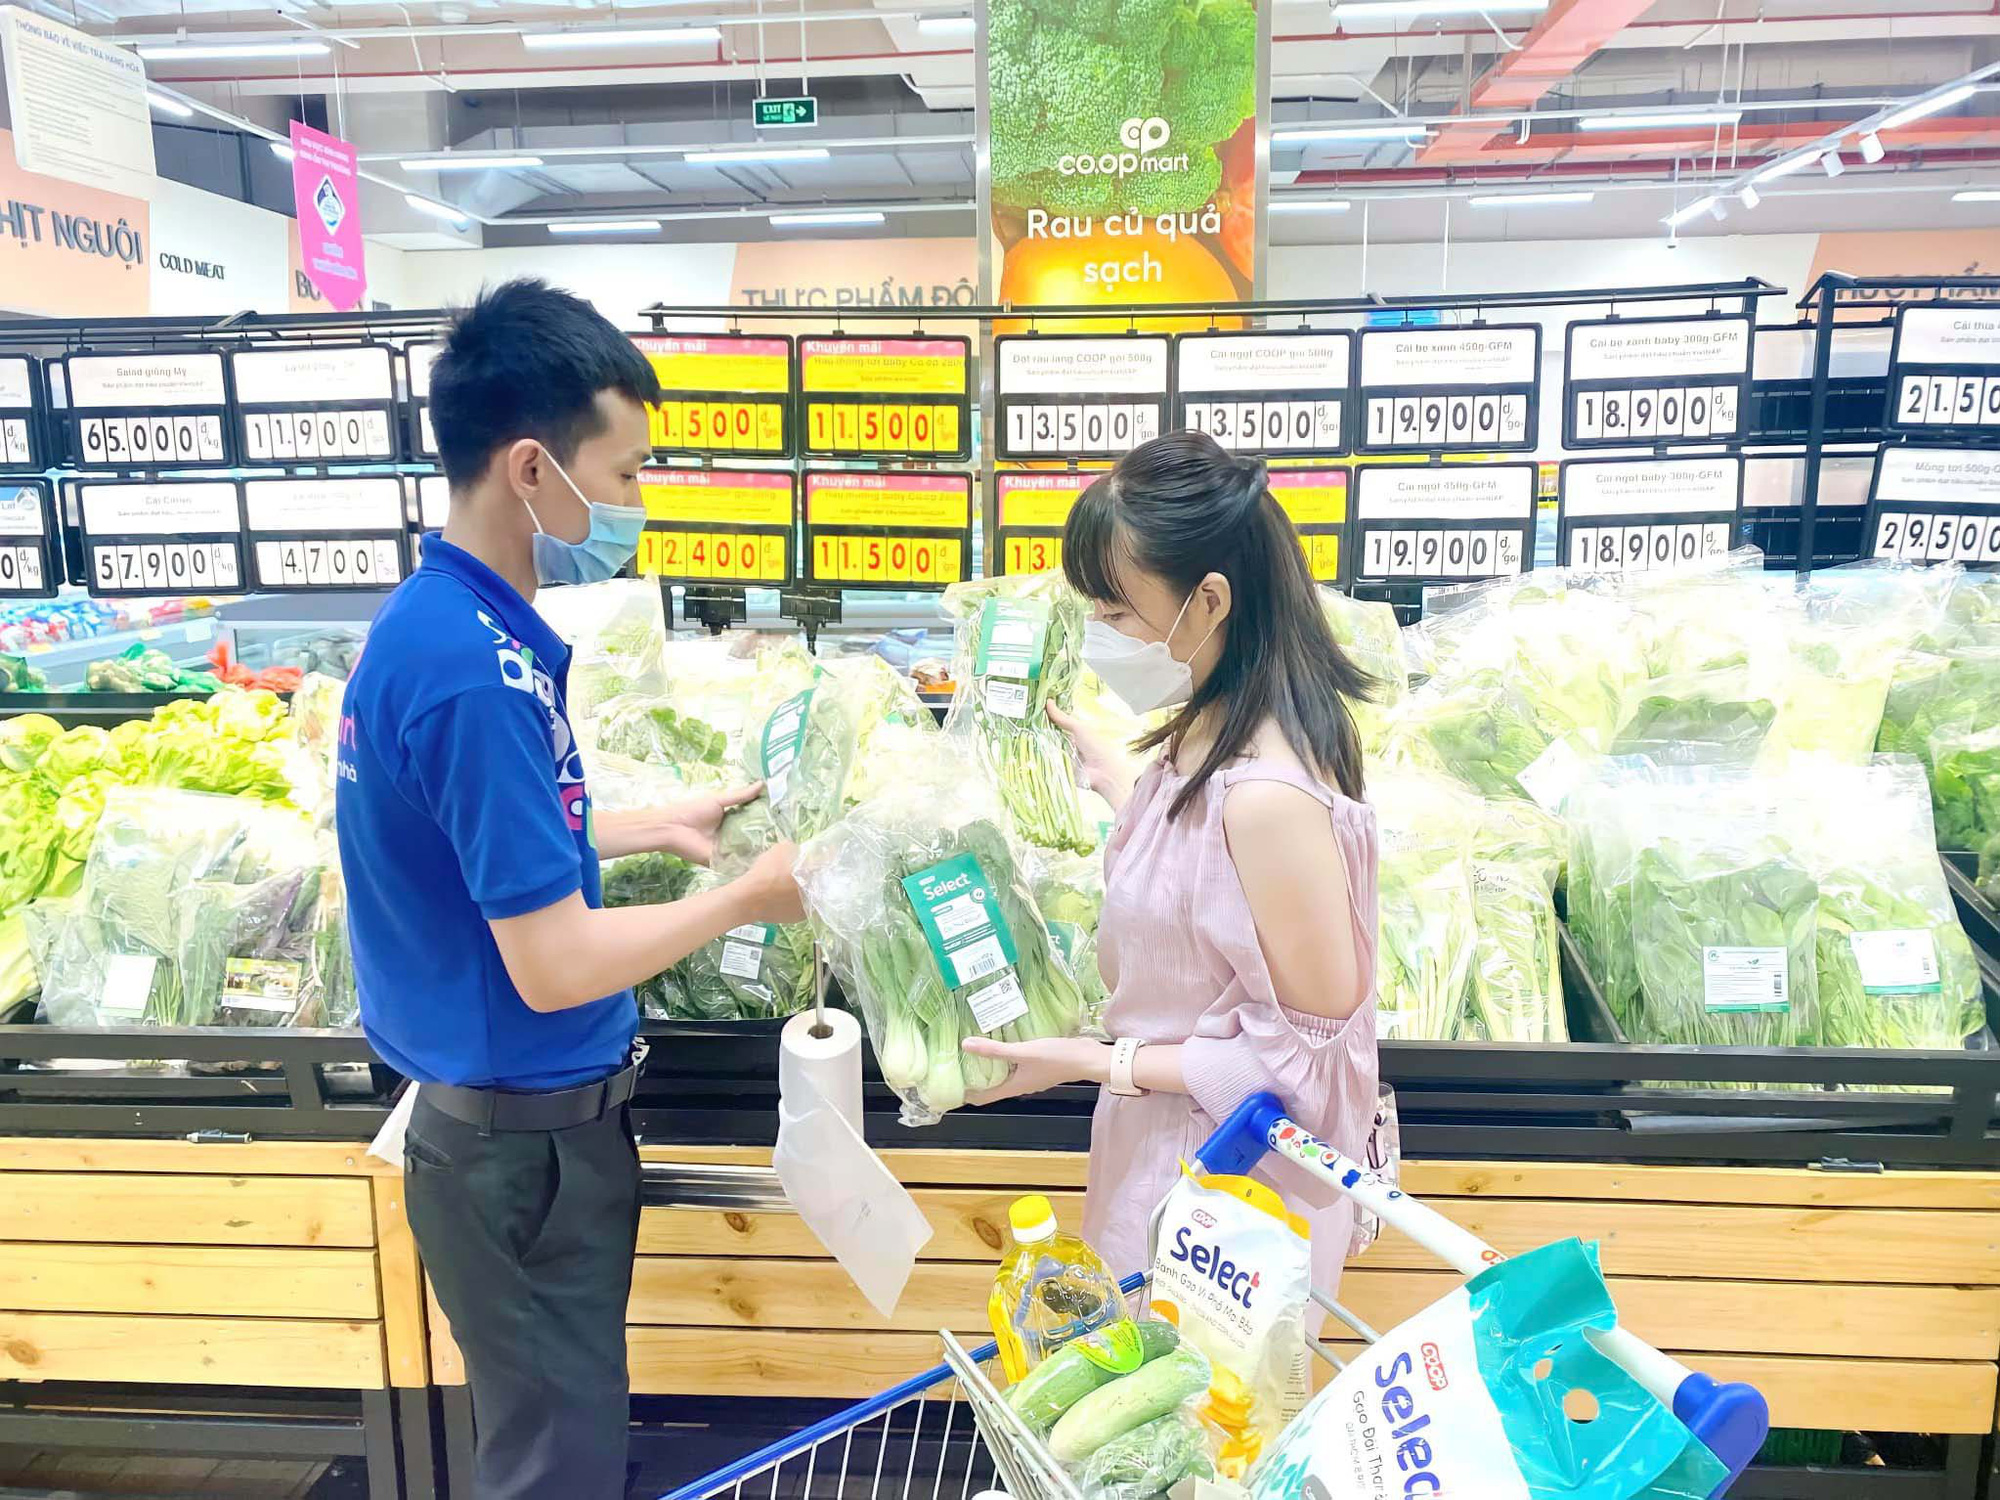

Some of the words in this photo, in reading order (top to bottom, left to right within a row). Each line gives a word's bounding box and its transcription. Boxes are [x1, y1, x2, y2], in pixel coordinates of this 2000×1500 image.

[1027, 208, 1092, 240] Rau
[1104, 206, 1143, 236] củ
[1155, 204, 1221, 243] quả
[51, 211, 144, 270] NGUỘI
[159, 252, 193, 274] COLD
[195, 260, 226, 280] MEAT
[1084, 251, 1162, 293] sạch
[931, 277, 979, 306] ĐÔ
[1076, 353, 1106, 363] COOP
[816, 411, 929, 441] 11.500
[1016, 412, 1128, 442] 13.500
[1195, 408, 1311, 439] 13.500
[1377, 402, 1495, 433] 19.900
[1586, 396, 1706, 427] 18.900
[87, 423, 193, 452] 65.000
[254, 418, 360, 448] 11.900
[284, 547, 369, 575] 4.700
[645, 537, 755, 569] 12.400
[821, 541, 930, 573] 11.500
[1374, 537, 1488, 567] 19.900
[1581, 532, 1696, 564] 18.900
[100, 549, 206, 580] 57.900
[922, 872, 972, 901] Select
[1170, 1226, 1261, 1309] Select
